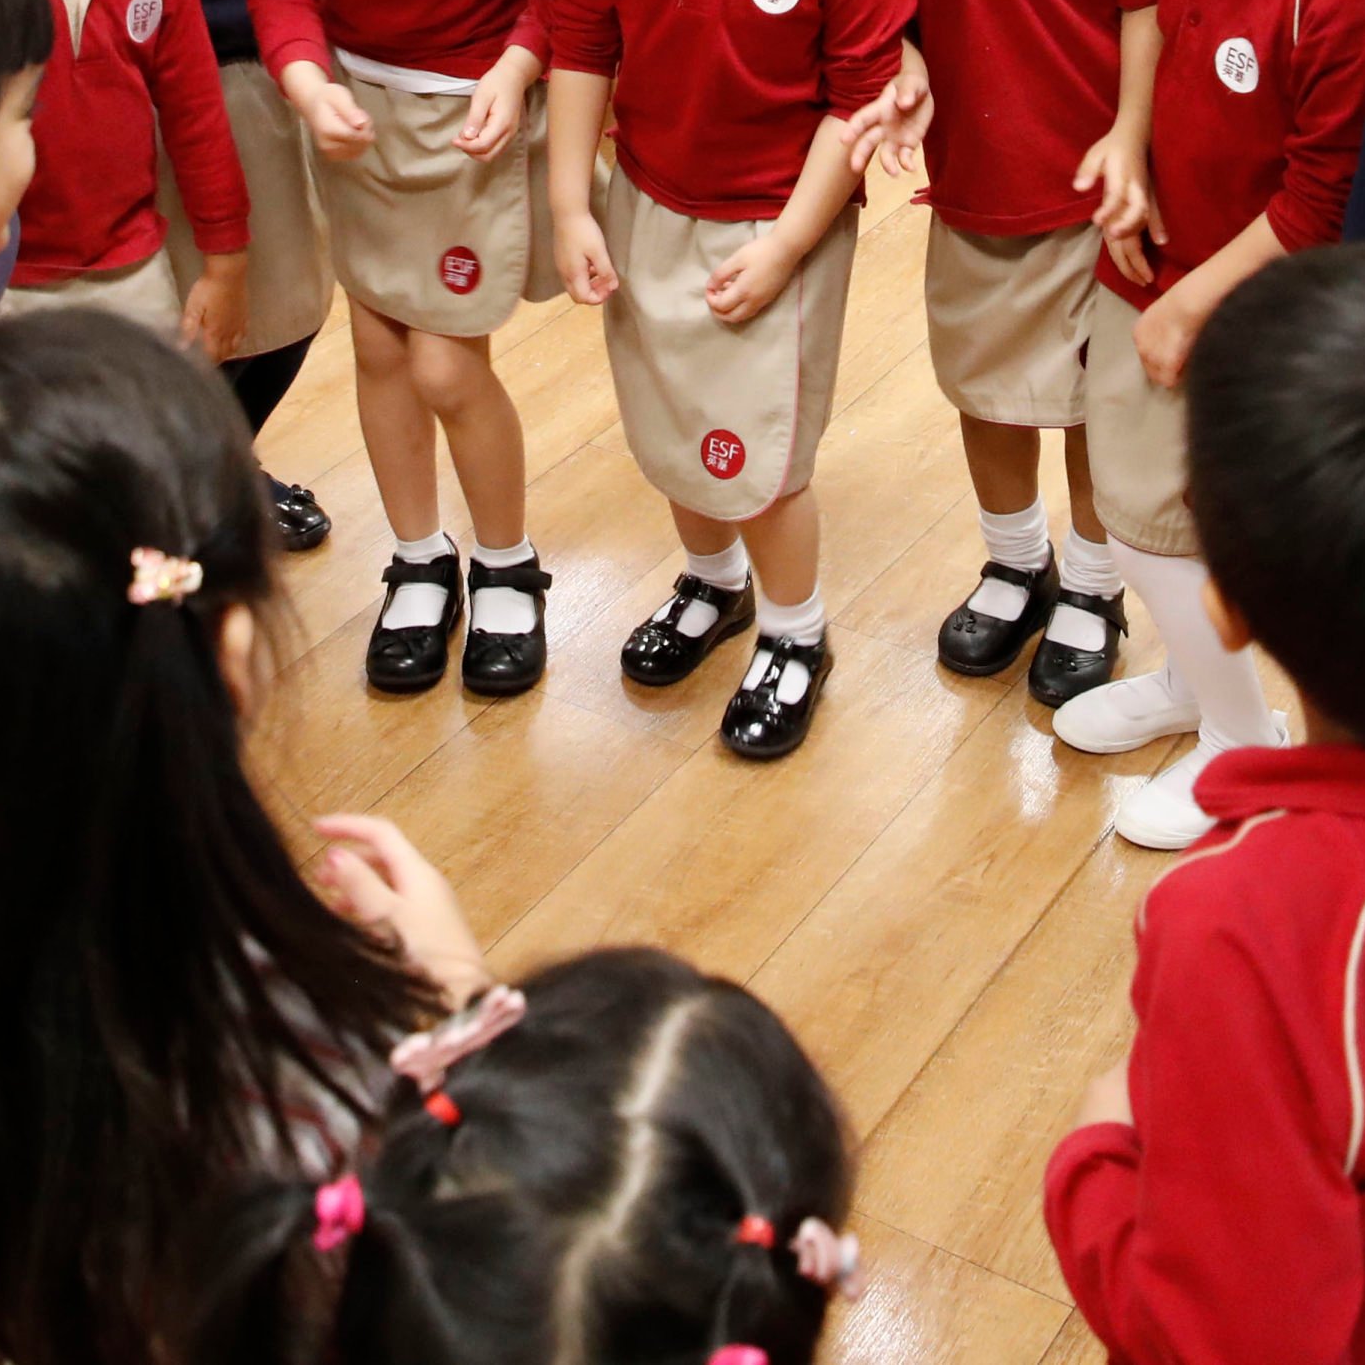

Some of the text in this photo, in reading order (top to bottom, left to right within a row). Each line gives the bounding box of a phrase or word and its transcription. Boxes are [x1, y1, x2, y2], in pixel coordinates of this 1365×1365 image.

[133, 1, 157, 19] ESF
[1226, 46, 1255, 72] ESF
[445, 256, 477, 275] ESF
[709, 438, 740, 459] ESF
